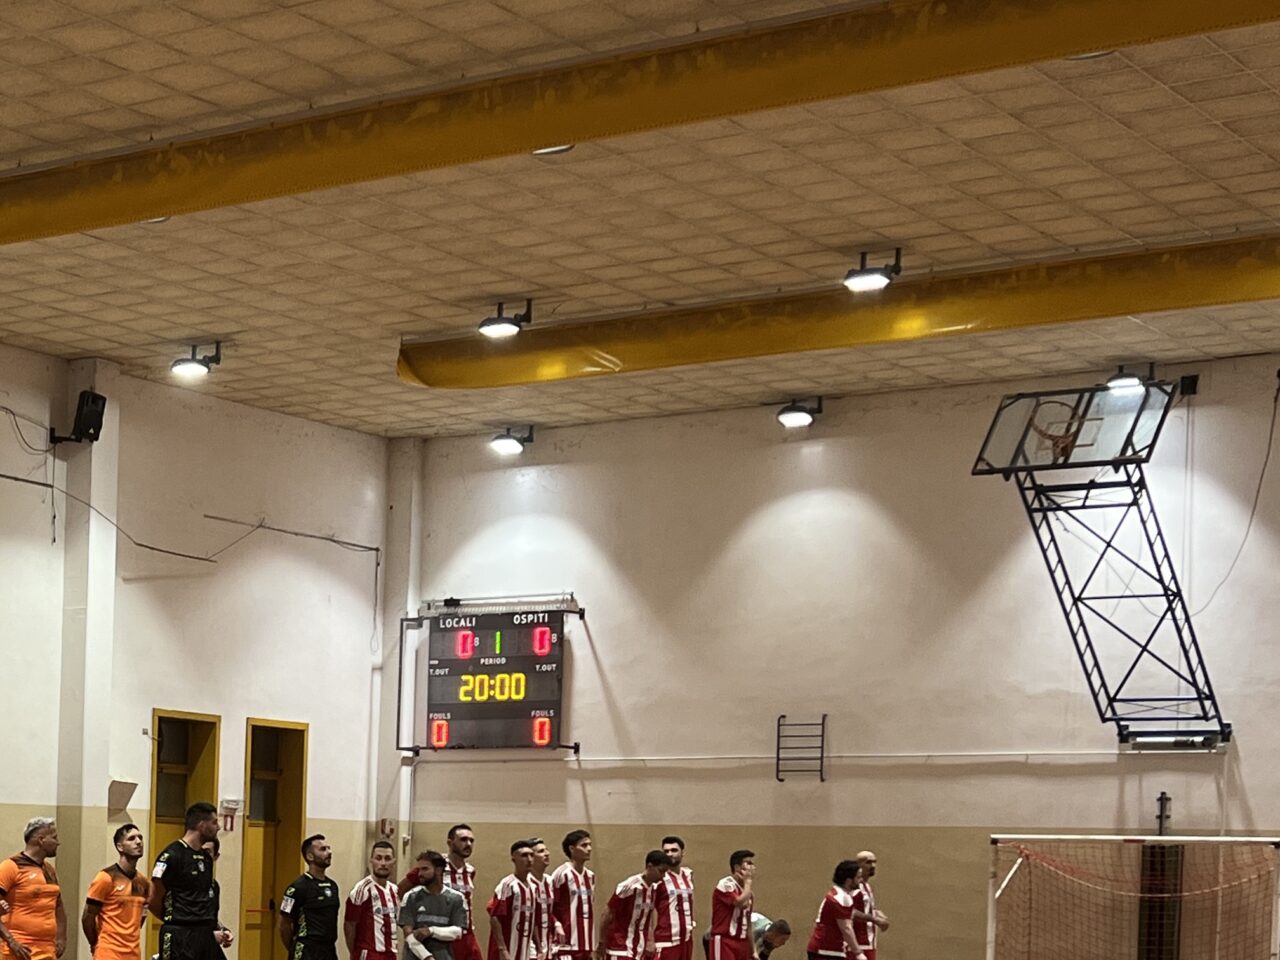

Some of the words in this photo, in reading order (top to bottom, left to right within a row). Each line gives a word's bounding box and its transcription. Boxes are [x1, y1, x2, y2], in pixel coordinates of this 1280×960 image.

[439, 617, 476, 628] LOCALI
[513, 613, 548, 625] OSPITI
[456, 630, 474, 659] 0
[495, 630, 501, 654] 1
[533, 627, 551, 656] 0
[480, 657, 506, 665] PERIOD
[536, 664, 557, 672] T.OUT
[429, 668, 450, 676] T.OUT
[459, 672, 526, 702] 20:00
[531, 709, 555, 717] FOULS
[432, 720, 449, 747] 0
[533, 717, 551, 746] 0
